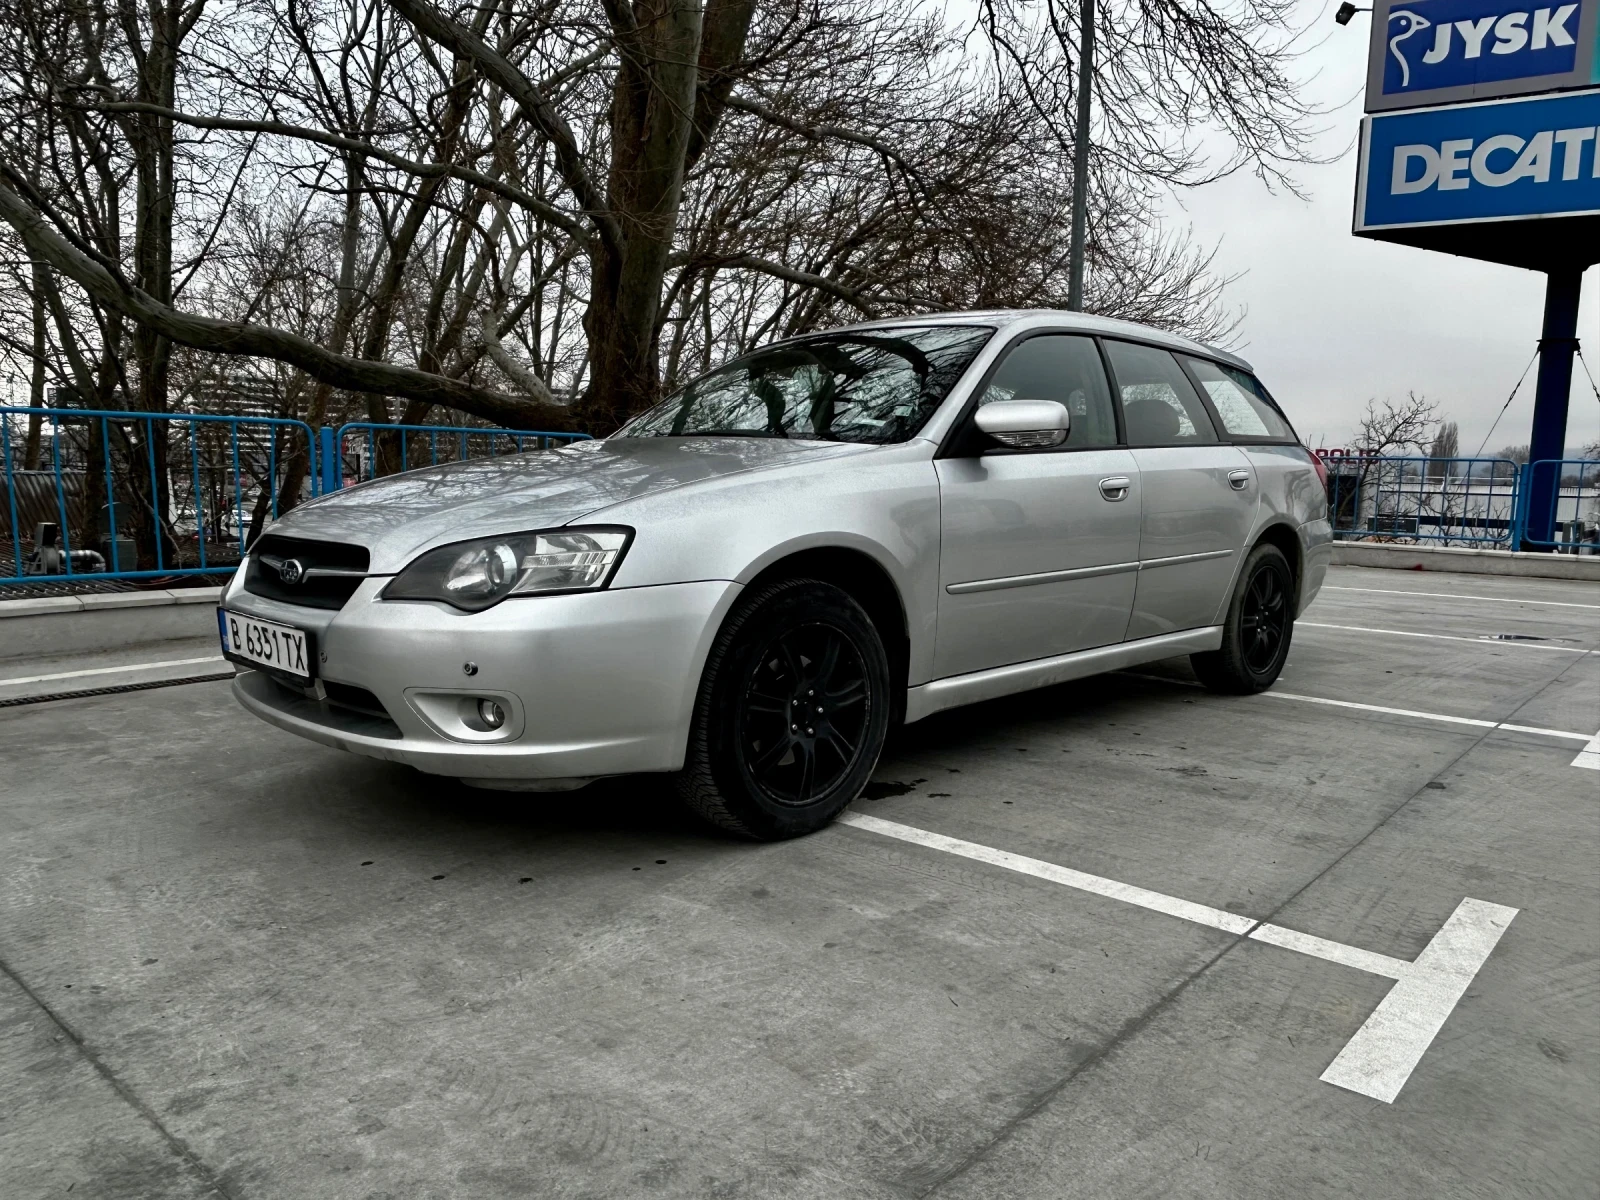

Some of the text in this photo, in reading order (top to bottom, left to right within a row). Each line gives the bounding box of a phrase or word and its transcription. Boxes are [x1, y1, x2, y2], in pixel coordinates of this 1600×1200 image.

[1422, 3, 1579, 64] JYSK
[1391, 125, 1600, 195] DECAT
[230, 617, 241, 650] B
